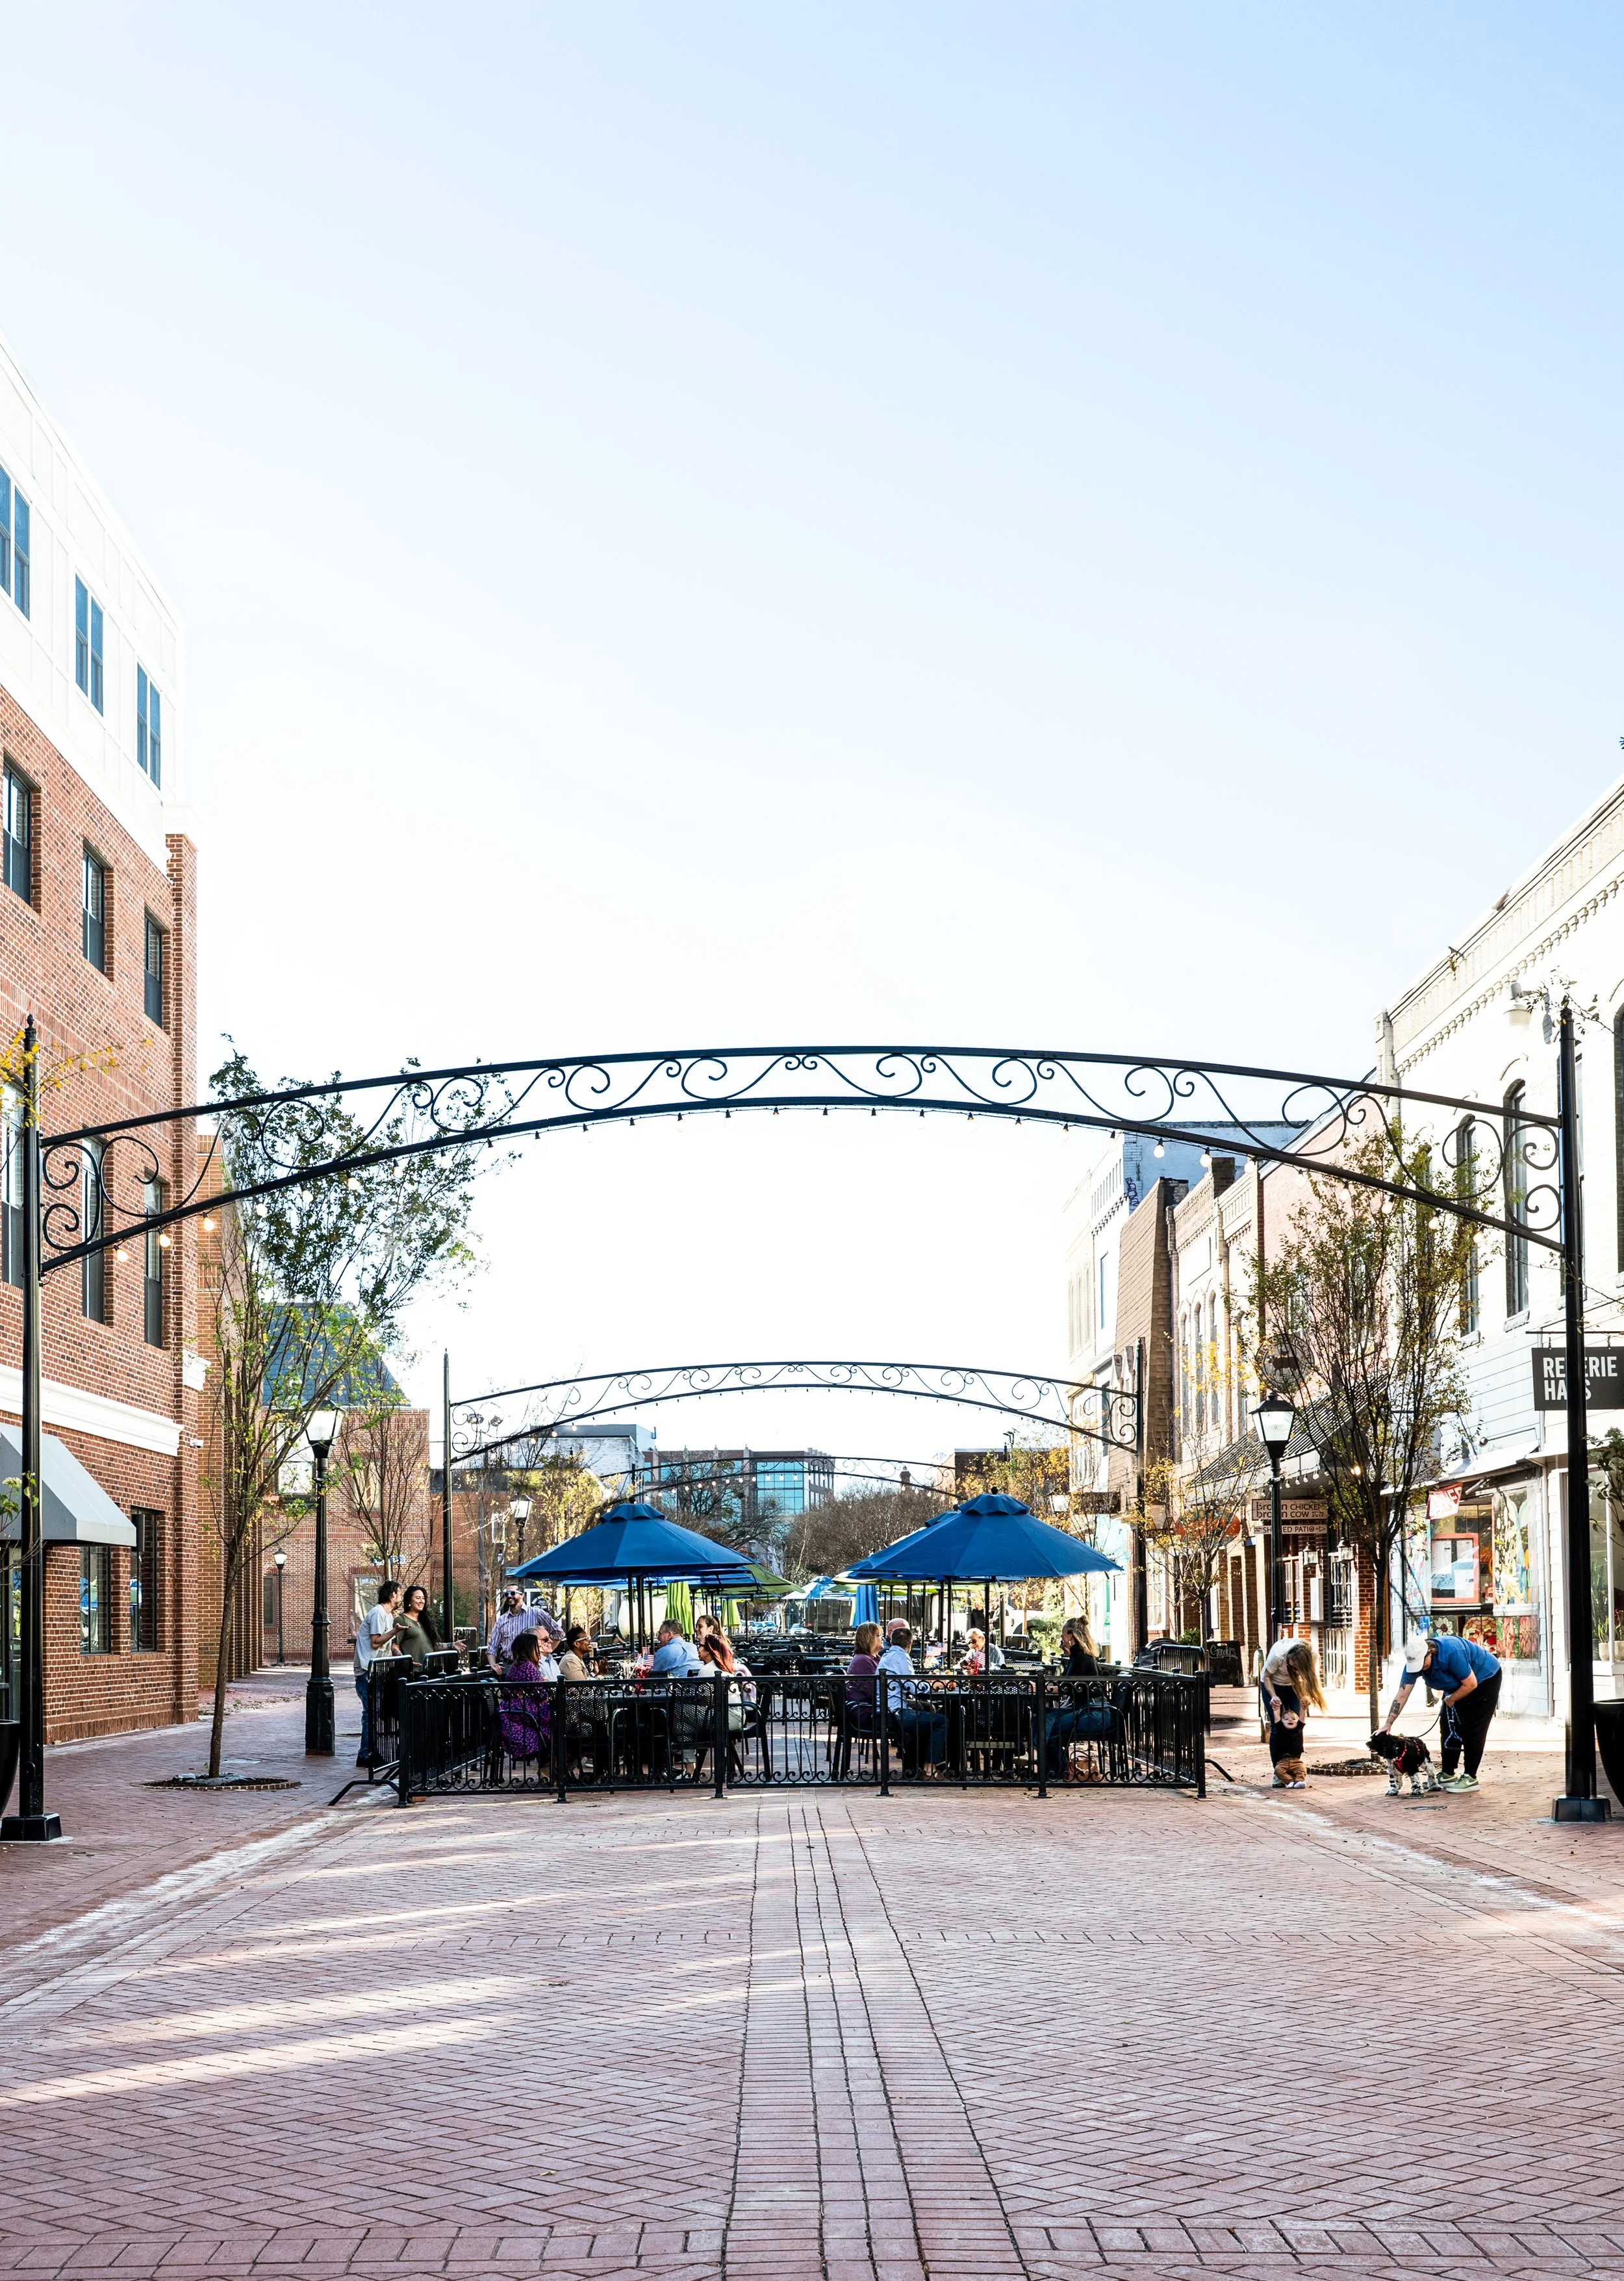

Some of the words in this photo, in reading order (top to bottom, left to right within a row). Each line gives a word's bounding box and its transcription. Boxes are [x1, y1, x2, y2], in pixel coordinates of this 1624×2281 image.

[1543, 1356, 1618, 1378] RERIE
[1544, 1379, 1592, 1400] HAS
[1256, 1501, 1287, 1510] bron
